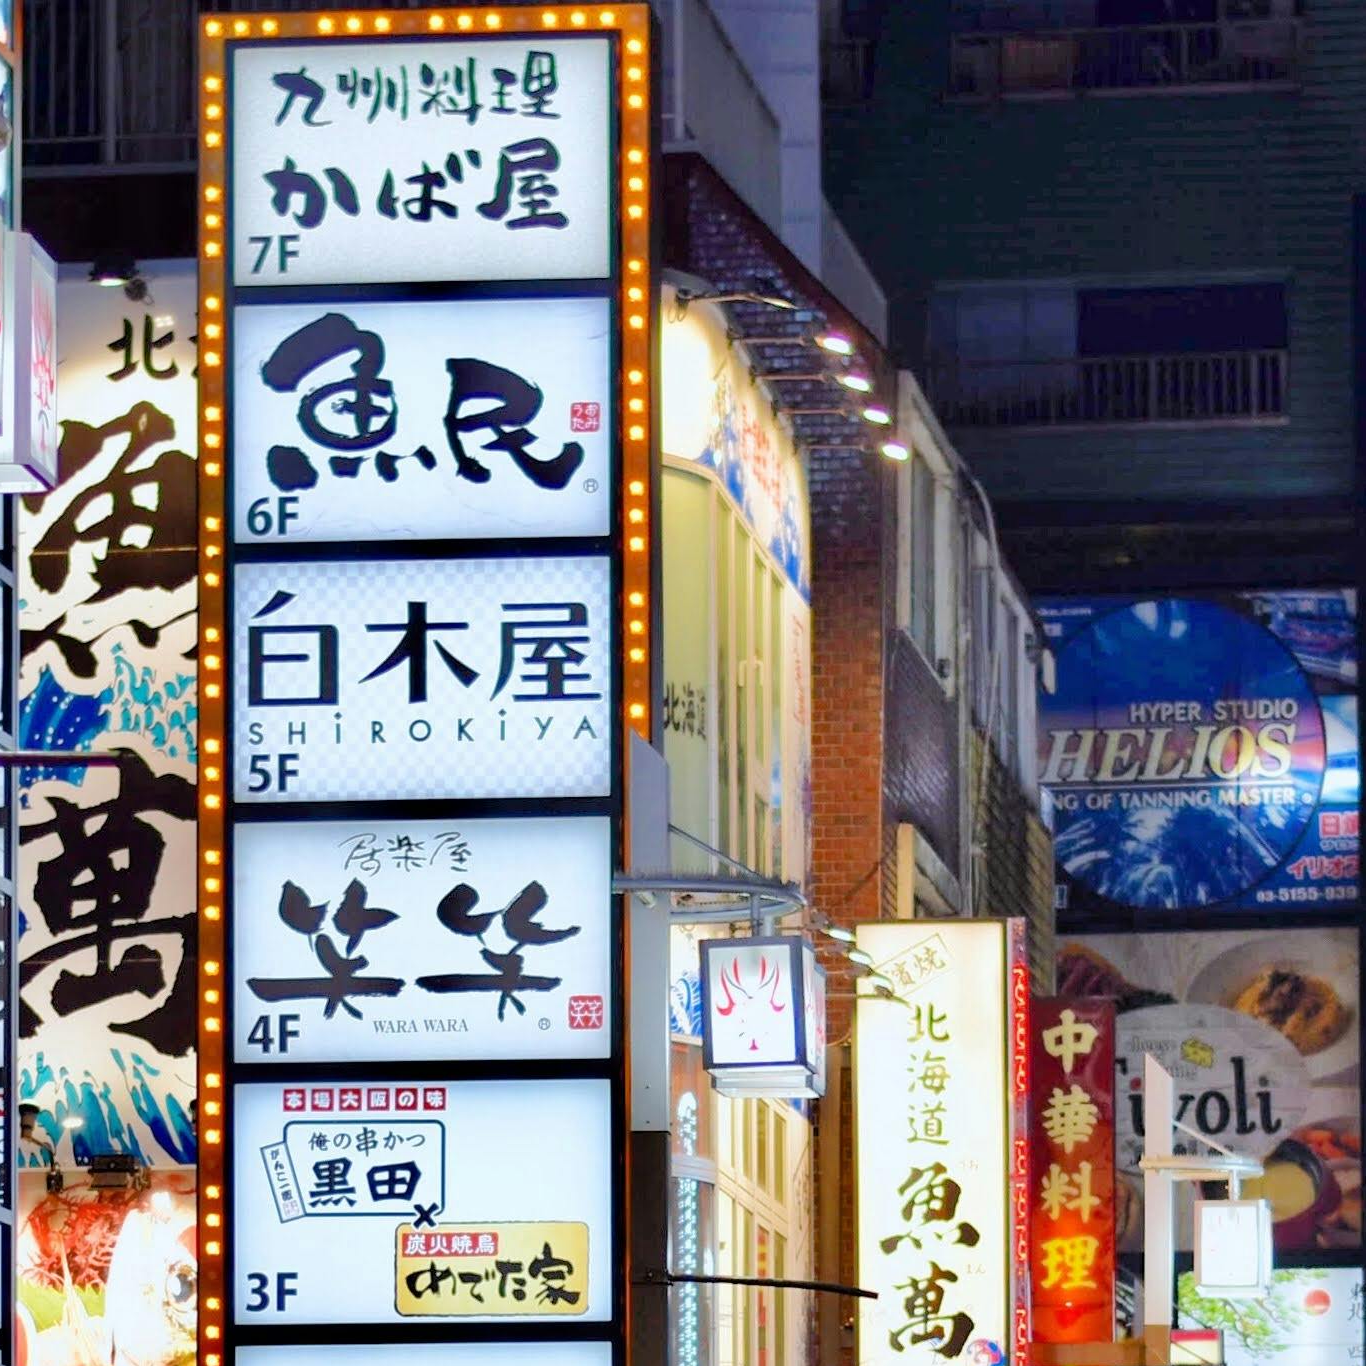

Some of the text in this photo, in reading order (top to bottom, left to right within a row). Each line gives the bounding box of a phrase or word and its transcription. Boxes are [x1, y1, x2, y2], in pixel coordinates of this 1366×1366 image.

[271, 51, 561, 126] 九州料理
[263, 137, 570, 229] かば屋
[248, 234, 301, 274] 7F
[261, 312, 586, 492] 魚民
[246, 497, 300, 536] 6F
[247, 590, 603, 708] 白木屋
[1130, 699, 1298, 723] HYPER STUDIO
[247, 753, 300, 793] 5F
[1038, 723, 1298, 783] HELIOS
[1120, 790, 1212, 809] TANNING
[1218, 787, 1295, 807] MASTER
[246, 1013, 301, 1054] 4F
[372, 1018, 469, 1034] WARA WARA
[907, 1003, 951, 1147] 北海道
[308, 1127, 426, 1157] 俺の串かつ
[1041, 1008, 1102, 1292] 中華料理
[308, 1156, 423, 1209] 黒田
[404, 1234, 498, 1257] 炭火焼鳥
[880, 1161, 981, 1358] 魚萬
[245, 1272, 299, 1312] 3F
[405, 1241, 581, 1307] めでた家
